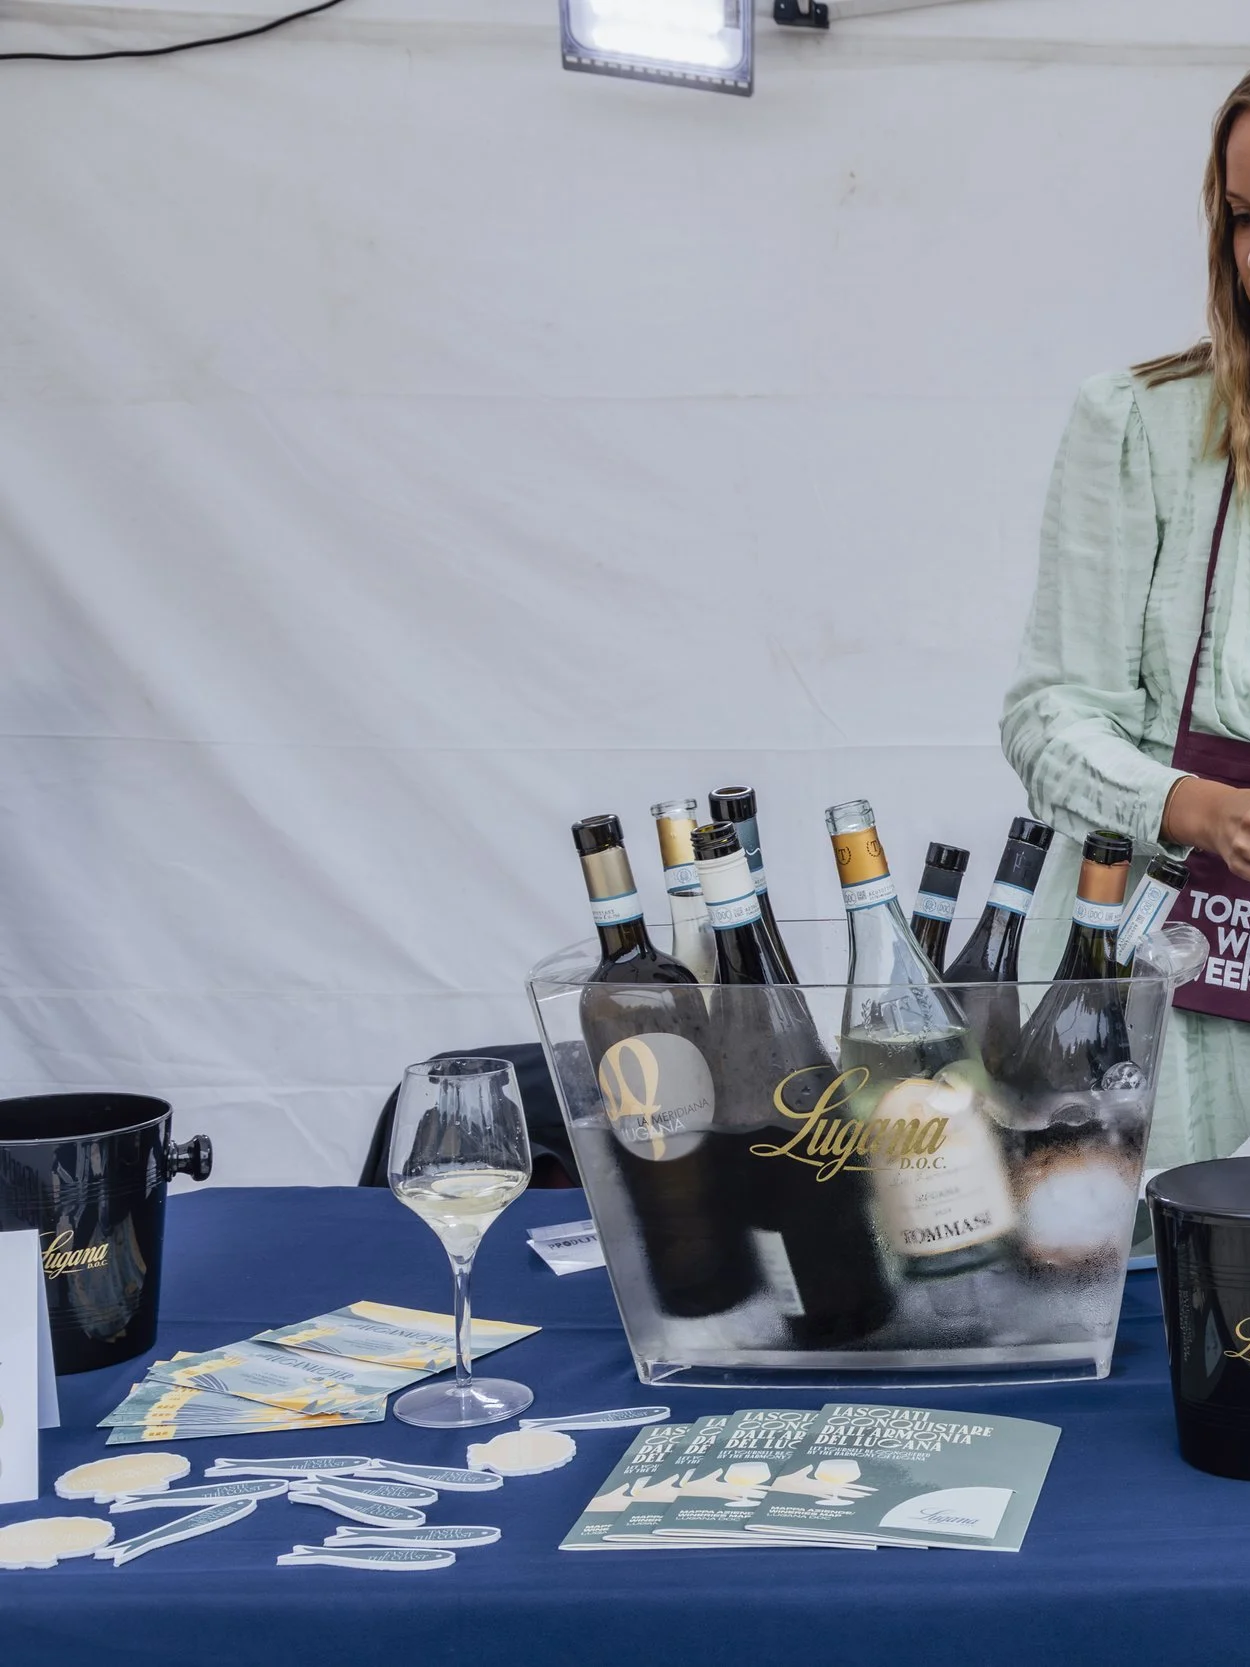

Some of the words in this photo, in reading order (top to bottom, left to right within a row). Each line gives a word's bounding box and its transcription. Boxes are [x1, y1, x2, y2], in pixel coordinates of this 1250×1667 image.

[637, 1117, 649, 1127] LA
[650, 1097, 710, 1126] MERIDIANA
[750, 1065, 949, 1182] Lugana
[900, 1156, 947, 1170] D.O.C.
[87, 1259, 109, 1269] D.O.C.
[832, 1406, 931, 1422] LASCIATI
[820, 1424, 972, 1445] DALL'ARMONIA
[827, 1416, 994, 1437] CONQUISTARE
[684, 1445, 711, 1454] DE
[725, 1438, 759, 1449] DEL
[815, 1434, 848, 1446] DEL
[853, 1436, 942, 1452] LUGANA
[632, 1453, 665, 1464] DEL
[911, 1506, 982, 1526] Lugana
